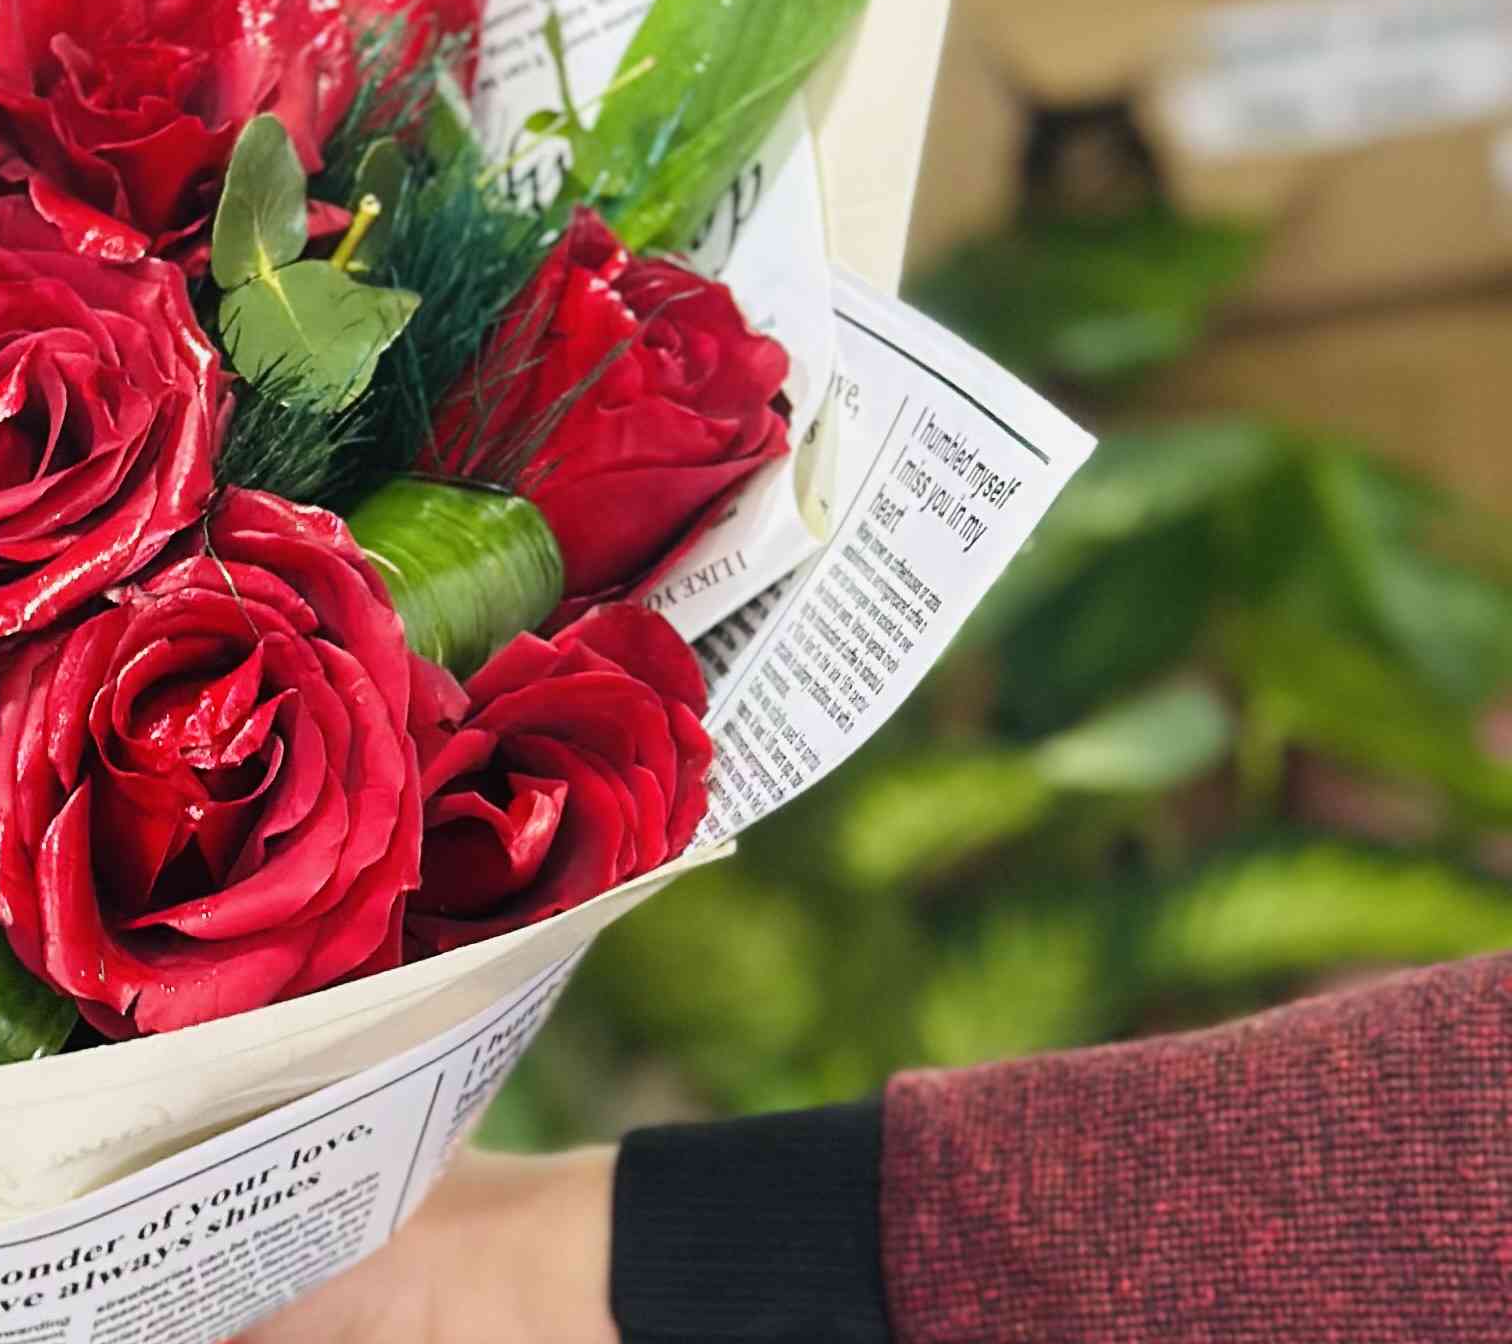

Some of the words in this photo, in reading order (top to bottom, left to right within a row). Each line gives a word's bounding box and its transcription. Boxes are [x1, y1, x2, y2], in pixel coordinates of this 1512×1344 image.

[911, 405, 930, 437] I
[889, 443, 909, 475] I
[919, 411, 981, 477] humbled
[896, 459, 933, 499] miss
[965, 460, 1023, 510] myself
[867, 481, 909, 535] heart
[918, 482, 956, 519] you
[945, 492, 967, 531] in
[958, 513, 989, 554] my
[679, 556, 736, 599] LIKE
[735, 549, 747, 570] I
[137, 1203, 182, 1241] of
[185, 1163, 279, 1226] your
[57, 1231, 194, 1301] always
[204, 1171, 322, 1240] shines
